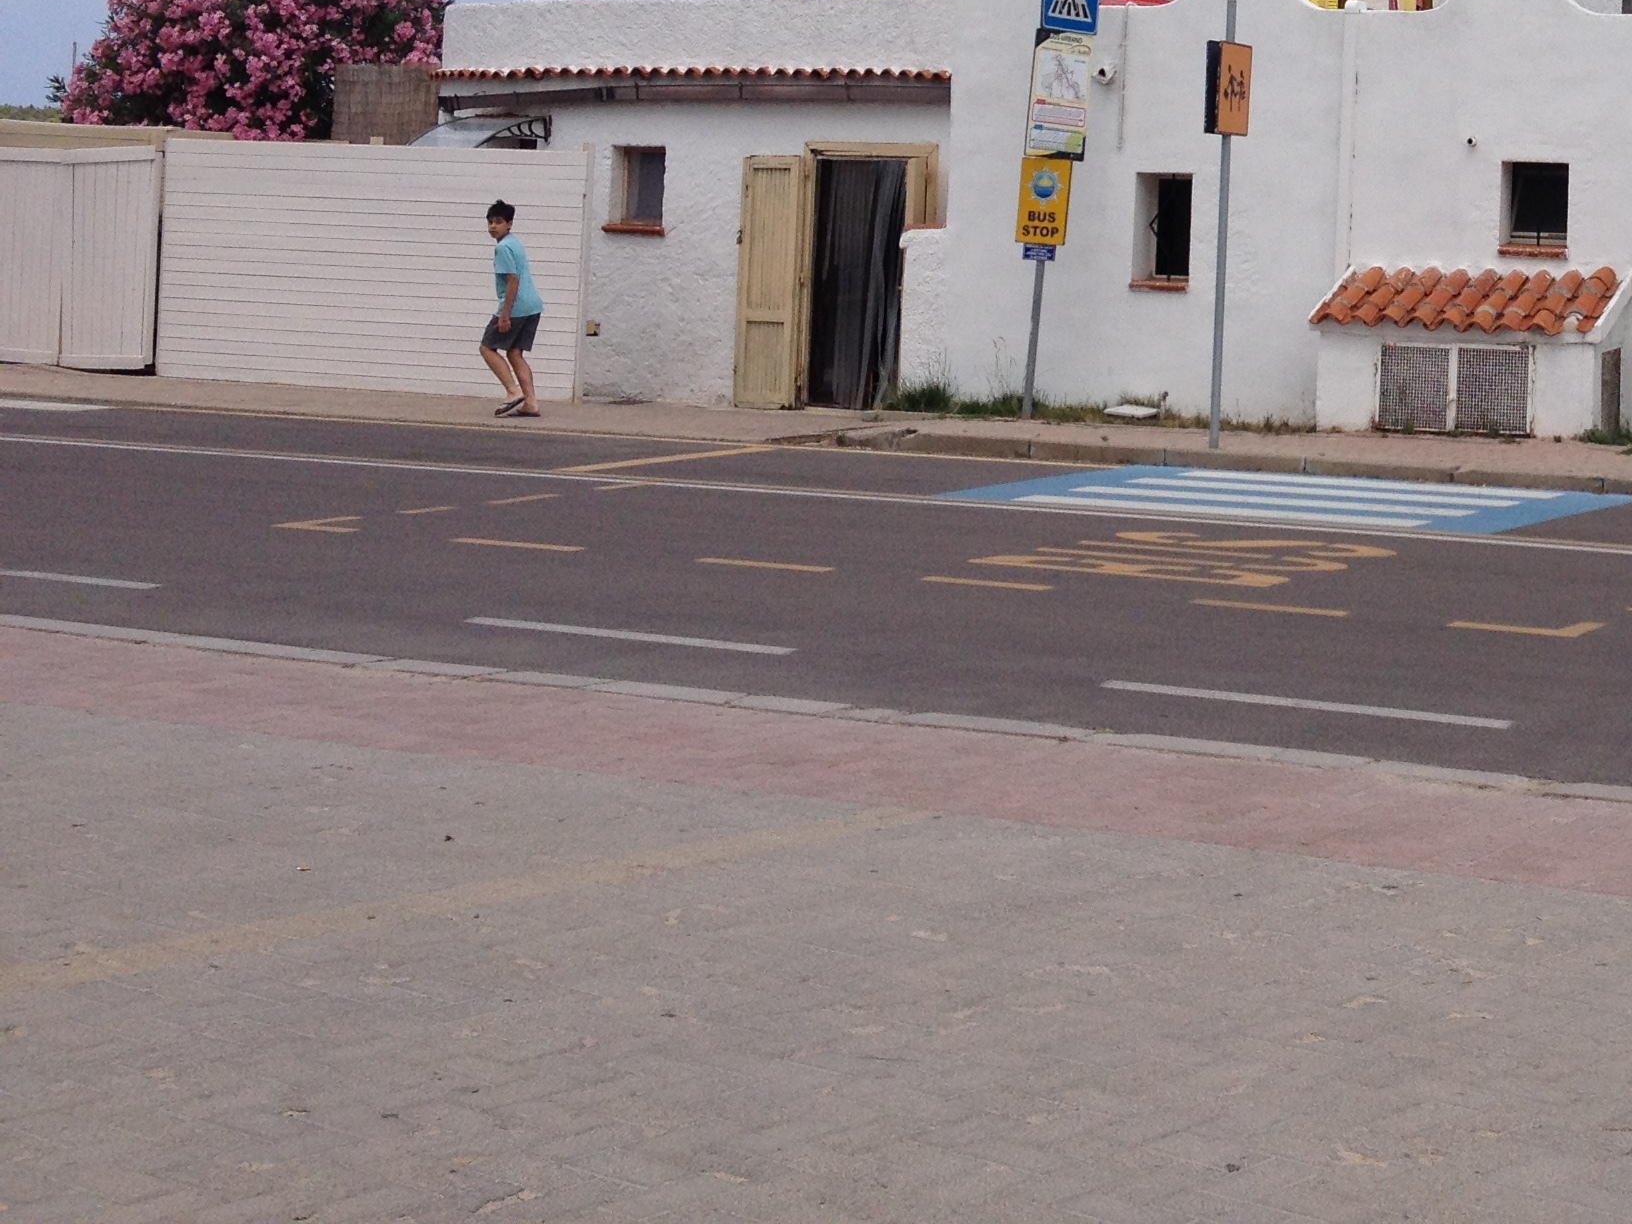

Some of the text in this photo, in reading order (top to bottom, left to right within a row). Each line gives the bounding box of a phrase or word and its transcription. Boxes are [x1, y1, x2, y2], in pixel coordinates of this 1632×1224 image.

[1027, 210, 1057, 223] BUS
[1022, 224, 1060, 238] STOP
[968, 531, 1398, 588] BUS
